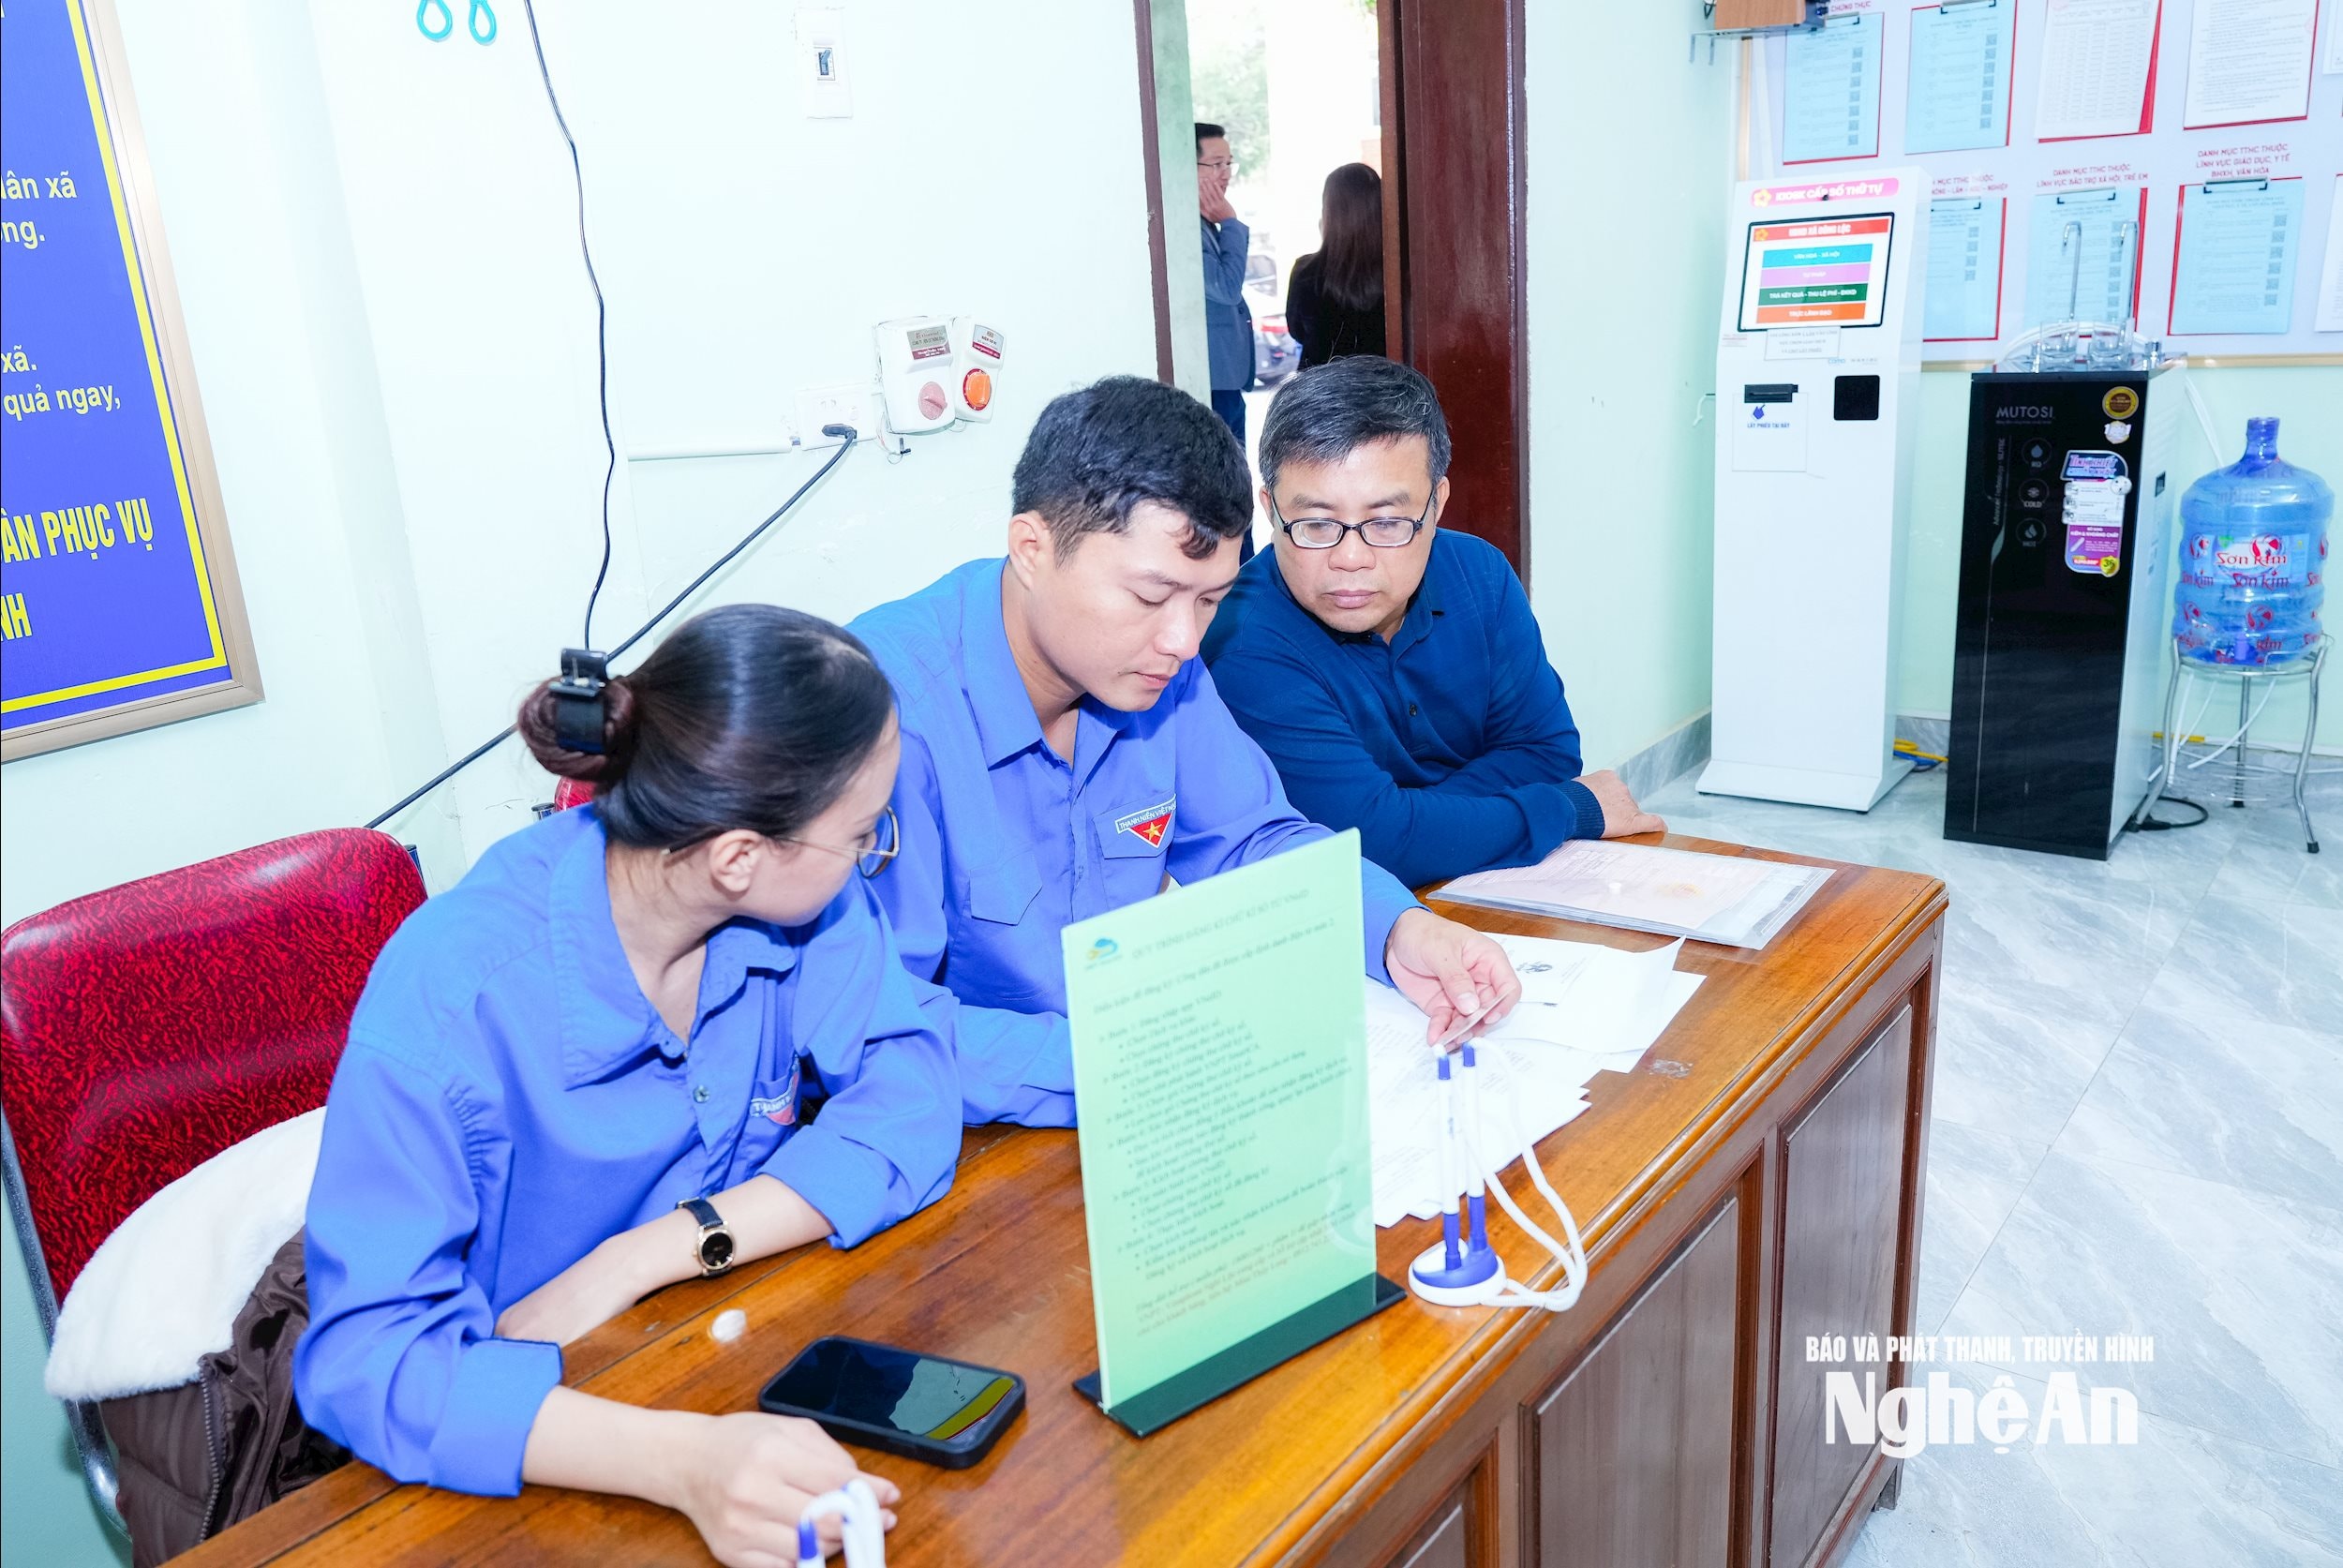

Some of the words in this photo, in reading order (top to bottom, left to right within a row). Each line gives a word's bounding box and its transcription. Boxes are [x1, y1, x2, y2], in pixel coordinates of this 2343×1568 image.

[45, 171, 77, 199] xã
[1775, 191, 1806, 201] KIOSK
[1807, 186, 1829, 200] CẤP
[1829, 184, 1844, 197] SỐ
[1868, 182, 1884, 196] TỰ
[1, 220, 45, 249] ng.
[1, 345, 37, 373] xã.
[4, 383, 51, 422] quả
[55, 384, 121, 415] ngay,
[1996, 406, 2053, 418] MUTOSI
[40, 503, 115, 560] PHỤC
[115, 498, 154, 551] VỤ
